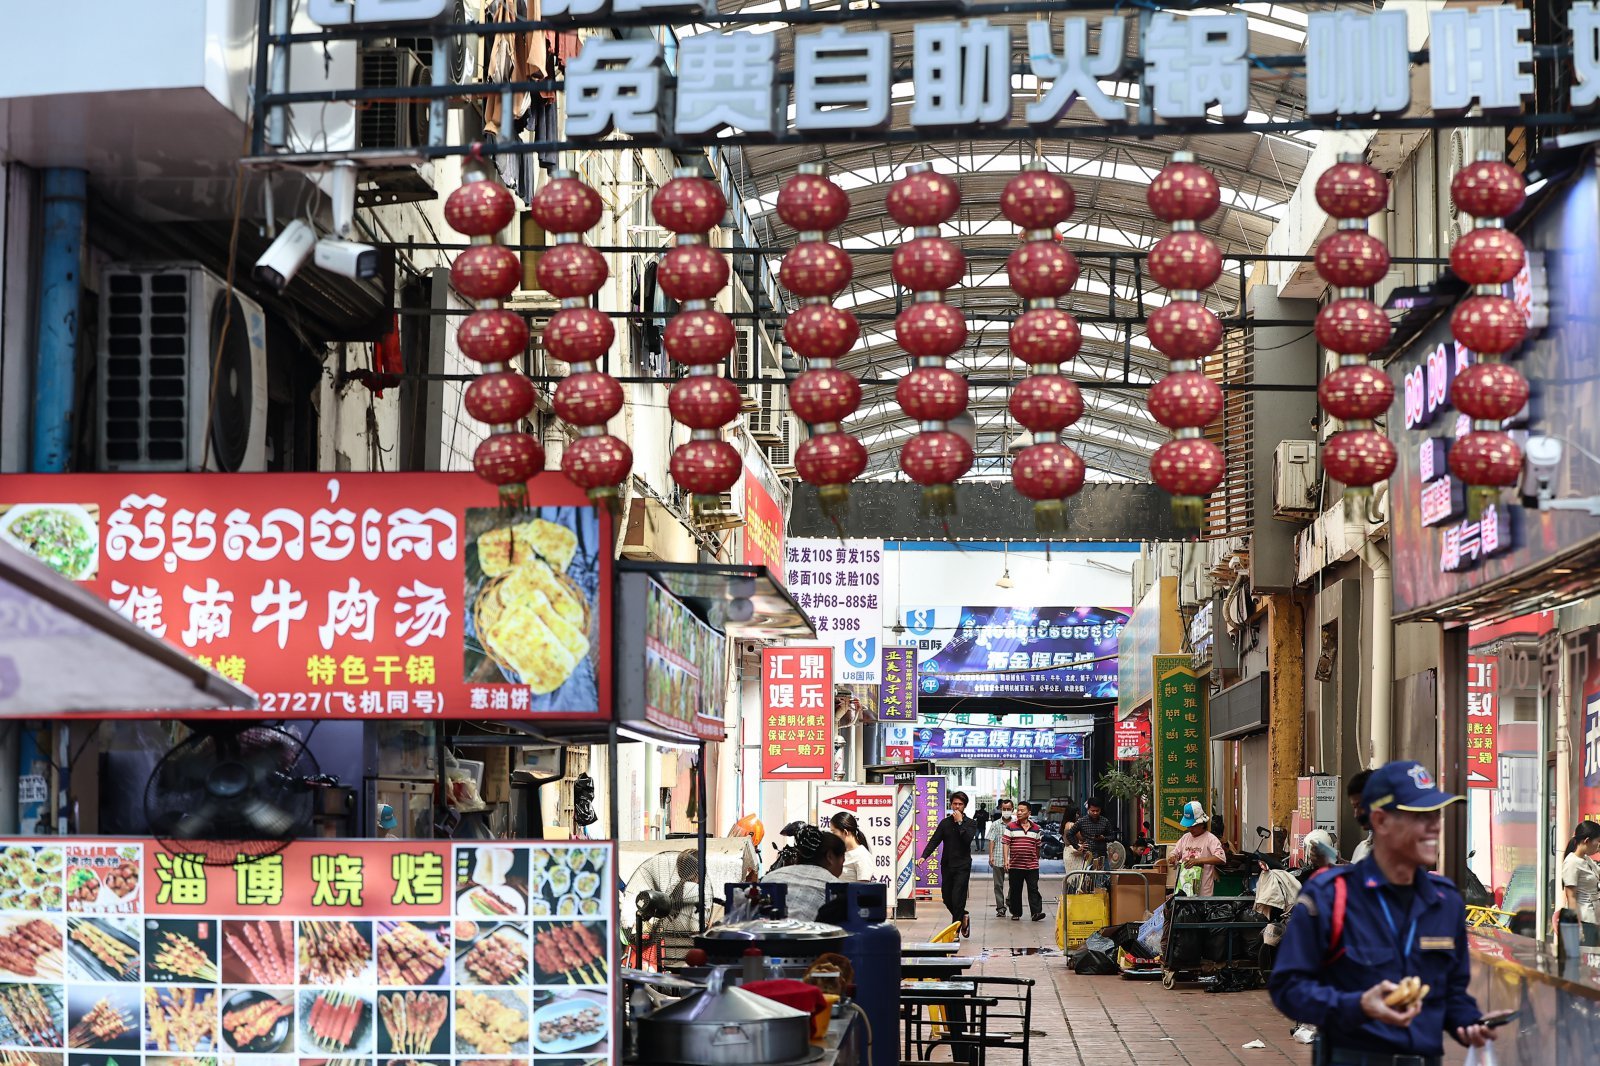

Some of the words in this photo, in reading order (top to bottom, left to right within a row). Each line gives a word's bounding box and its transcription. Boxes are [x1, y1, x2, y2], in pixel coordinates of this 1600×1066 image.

[108, 577, 451, 650] 淮南牛肉汤
[306, 655, 436, 685] 特色干锅
[769, 655, 825, 679] 汇鼎
[986, 651, 1096, 671] 拓金娱乐城
[843, 671, 875, 681] U8国际
[256, 690, 445, 713] 2727(飞机同号)
[470, 687, 530, 711] 葱油饼
[769, 684, 825, 709] 娱乐
[768, 714, 826, 727] 全透明化模式
[768, 729, 826, 741] 保证公平公正
[942, 730, 1056, 748] 拓金娱乐城
[1183, 682, 1199, 785] 铂雅电玩娱乐城
[768, 744, 827, 757] 假一赔万
[155, 852, 443, 907] 淄博烧烤
